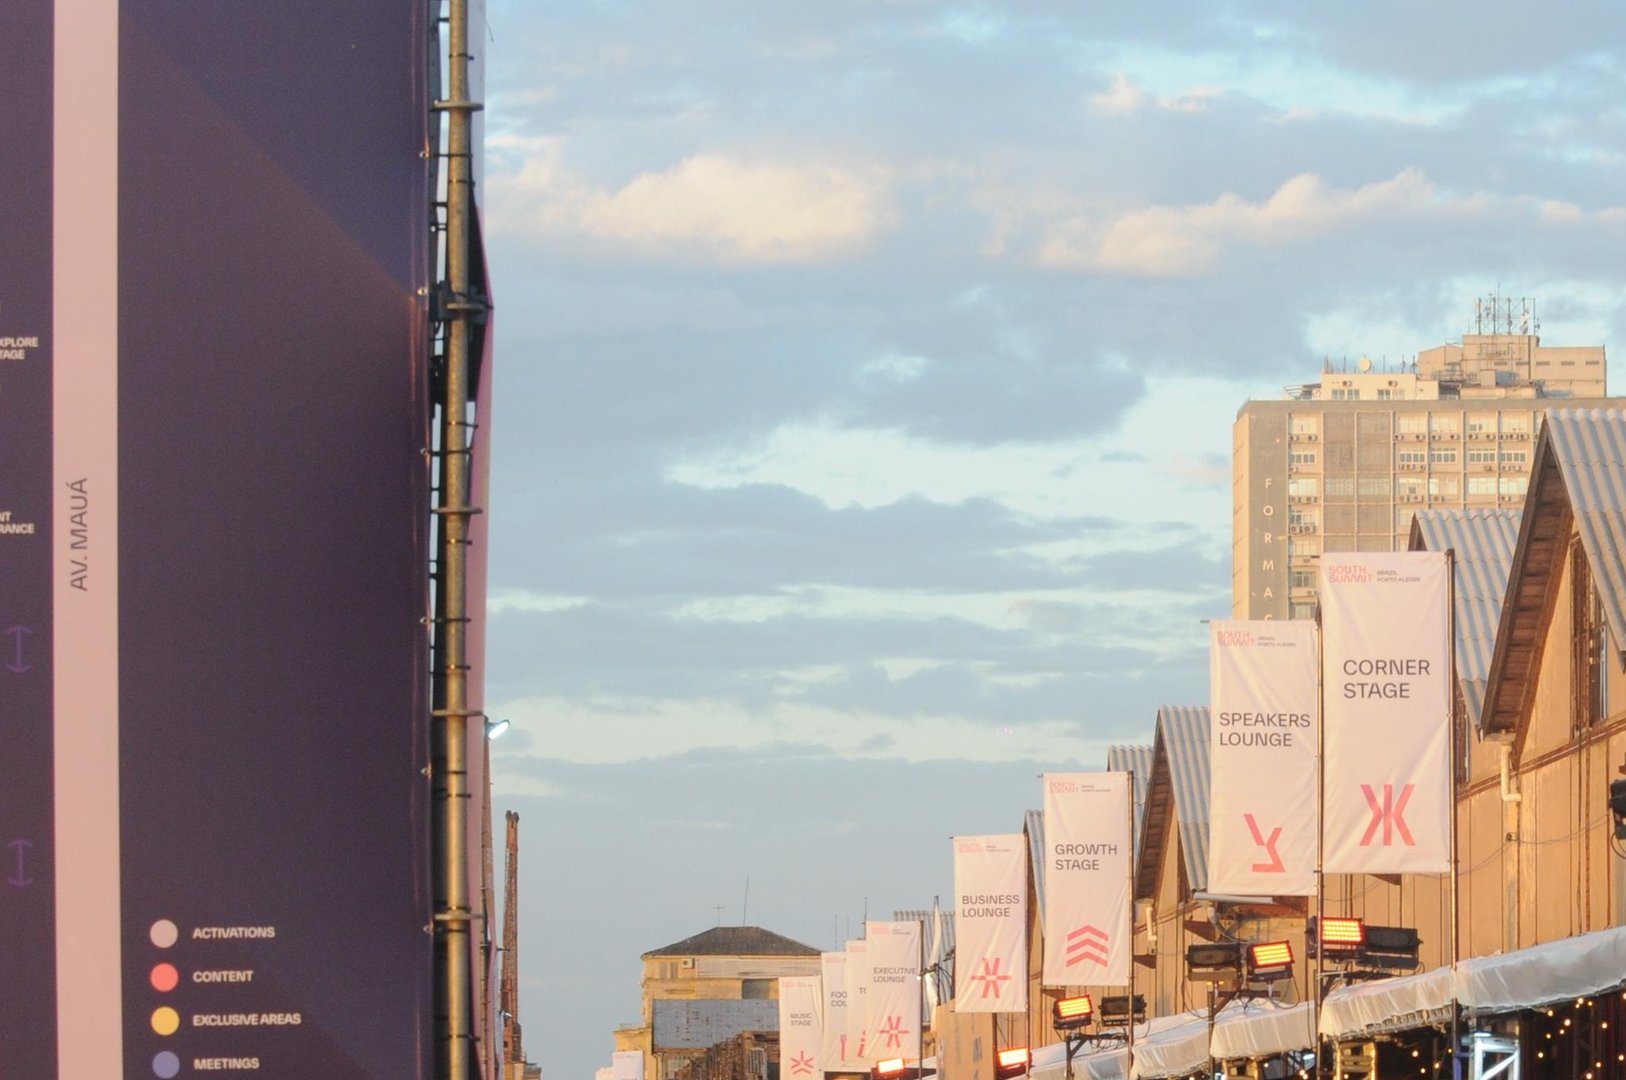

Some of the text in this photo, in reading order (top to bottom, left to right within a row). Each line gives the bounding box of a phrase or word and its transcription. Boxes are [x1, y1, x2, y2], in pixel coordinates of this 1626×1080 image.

[0, 337, 39, 347] XPLORE
[0, 349, 26, 360] TAGE
[0, 523, 35, 534] RANCE
[66, 477, 88, 591] AV. MAUÁ
[1329, 565, 1367, 575] SOUTH
[1217, 631, 1250, 640] SOUTH
[1342, 659, 1431, 677] CORNER
[1342, 682, 1411, 699] STAGE
[1219, 712, 1312, 728] SPEAKERS
[1219, 732, 1293, 747] LOUNGE
[1054, 844, 1118, 855] GROWTH
[1055, 859, 1100, 870] STAGE
[961, 895, 1020, 905] BUSINESS
[961, 908, 1011, 918] LOUNGE
[193, 927, 276, 940] ACTIVATIONS
[193, 970, 253, 983] CONTENT
[873, 967, 917, 975] EXECUTIVE
[831, 991, 847, 999] FOO
[193, 1013, 302, 1027] EXCLUSIVE AREAS
[194, 1058, 260, 1070] MEETINGS
